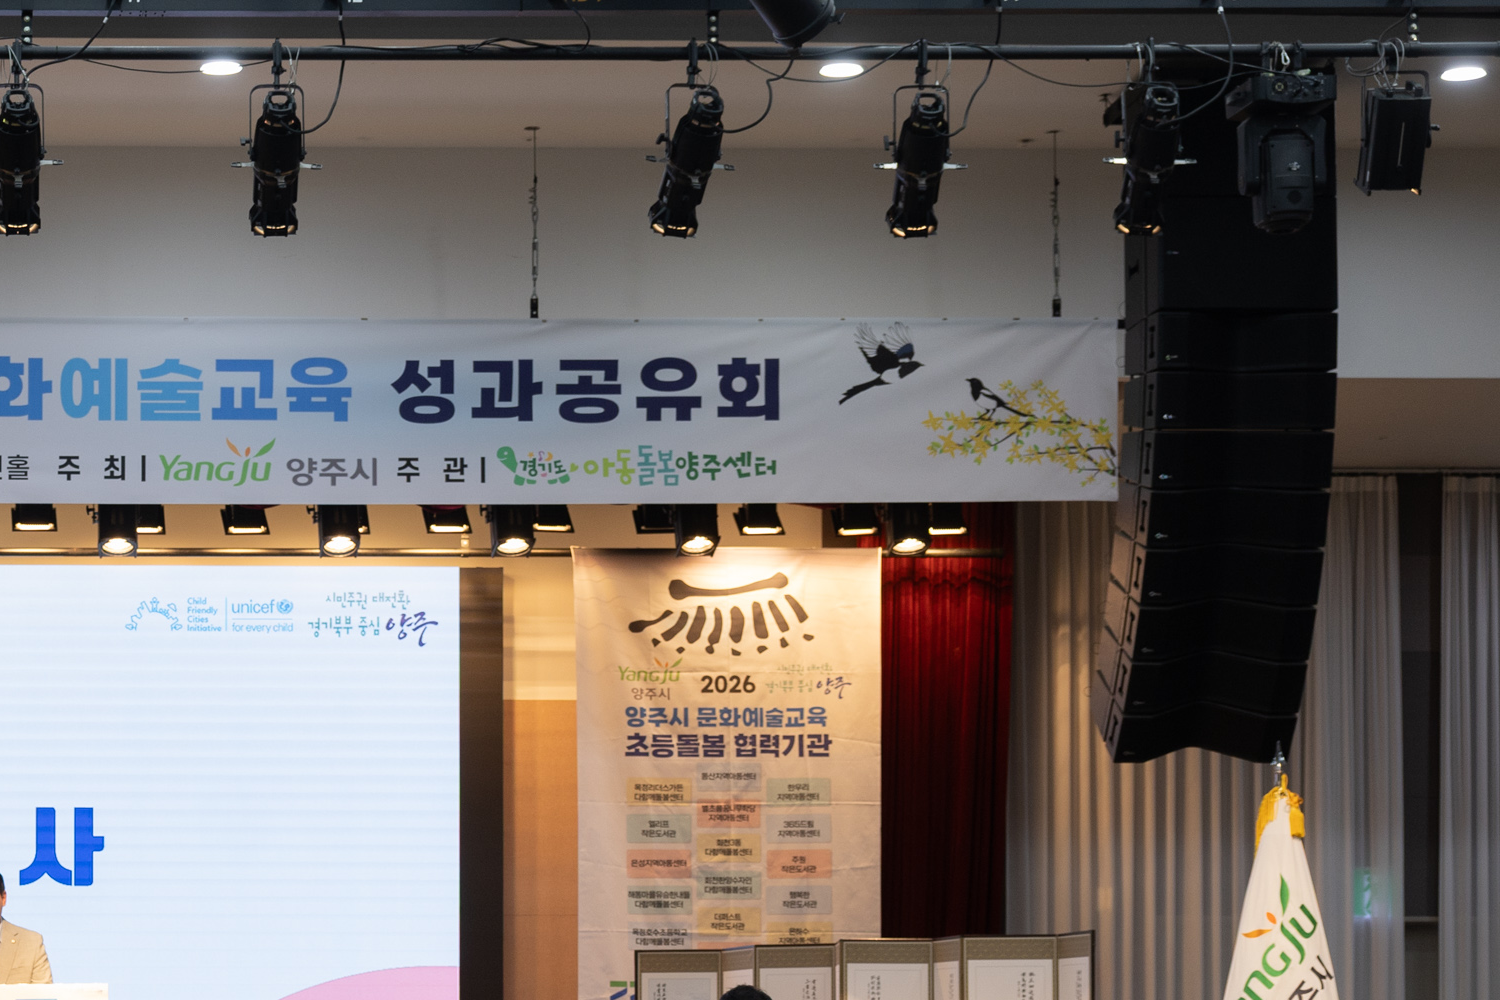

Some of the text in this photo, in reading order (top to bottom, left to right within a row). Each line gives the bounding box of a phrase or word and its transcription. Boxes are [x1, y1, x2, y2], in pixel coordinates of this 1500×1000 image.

[392, 356, 780, 423] 성과공유회
[57, 455, 82, 480] 주
[103, 454, 128, 481] 최
[286, 456, 378, 487] 양주시
[397, 444, 777, 486] 주 관 경기도 아동돌봄양주센터
[187, 597, 207, 605] Child
[231, 599, 275, 614] unicef
[326, 590, 411, 610] 시민주권 대전환
[187, 606, 218, 615] Friendly
[187, 615, 209, 623] Cities
[187, 624, 222, 632] Initiative
[232, 623, 293, 634] for every child
[308, 612, 438, 647] 경기북부 중심 양주
[631, 687, 671, 700] 양주시
[700, 675, 756, 693] 2026
[625, 706, 827, 727] 양주시 문화예술교육
[624, 733, 833, 757] 초등돌봄 협력기관
[19, 807, 104, 886] 사
